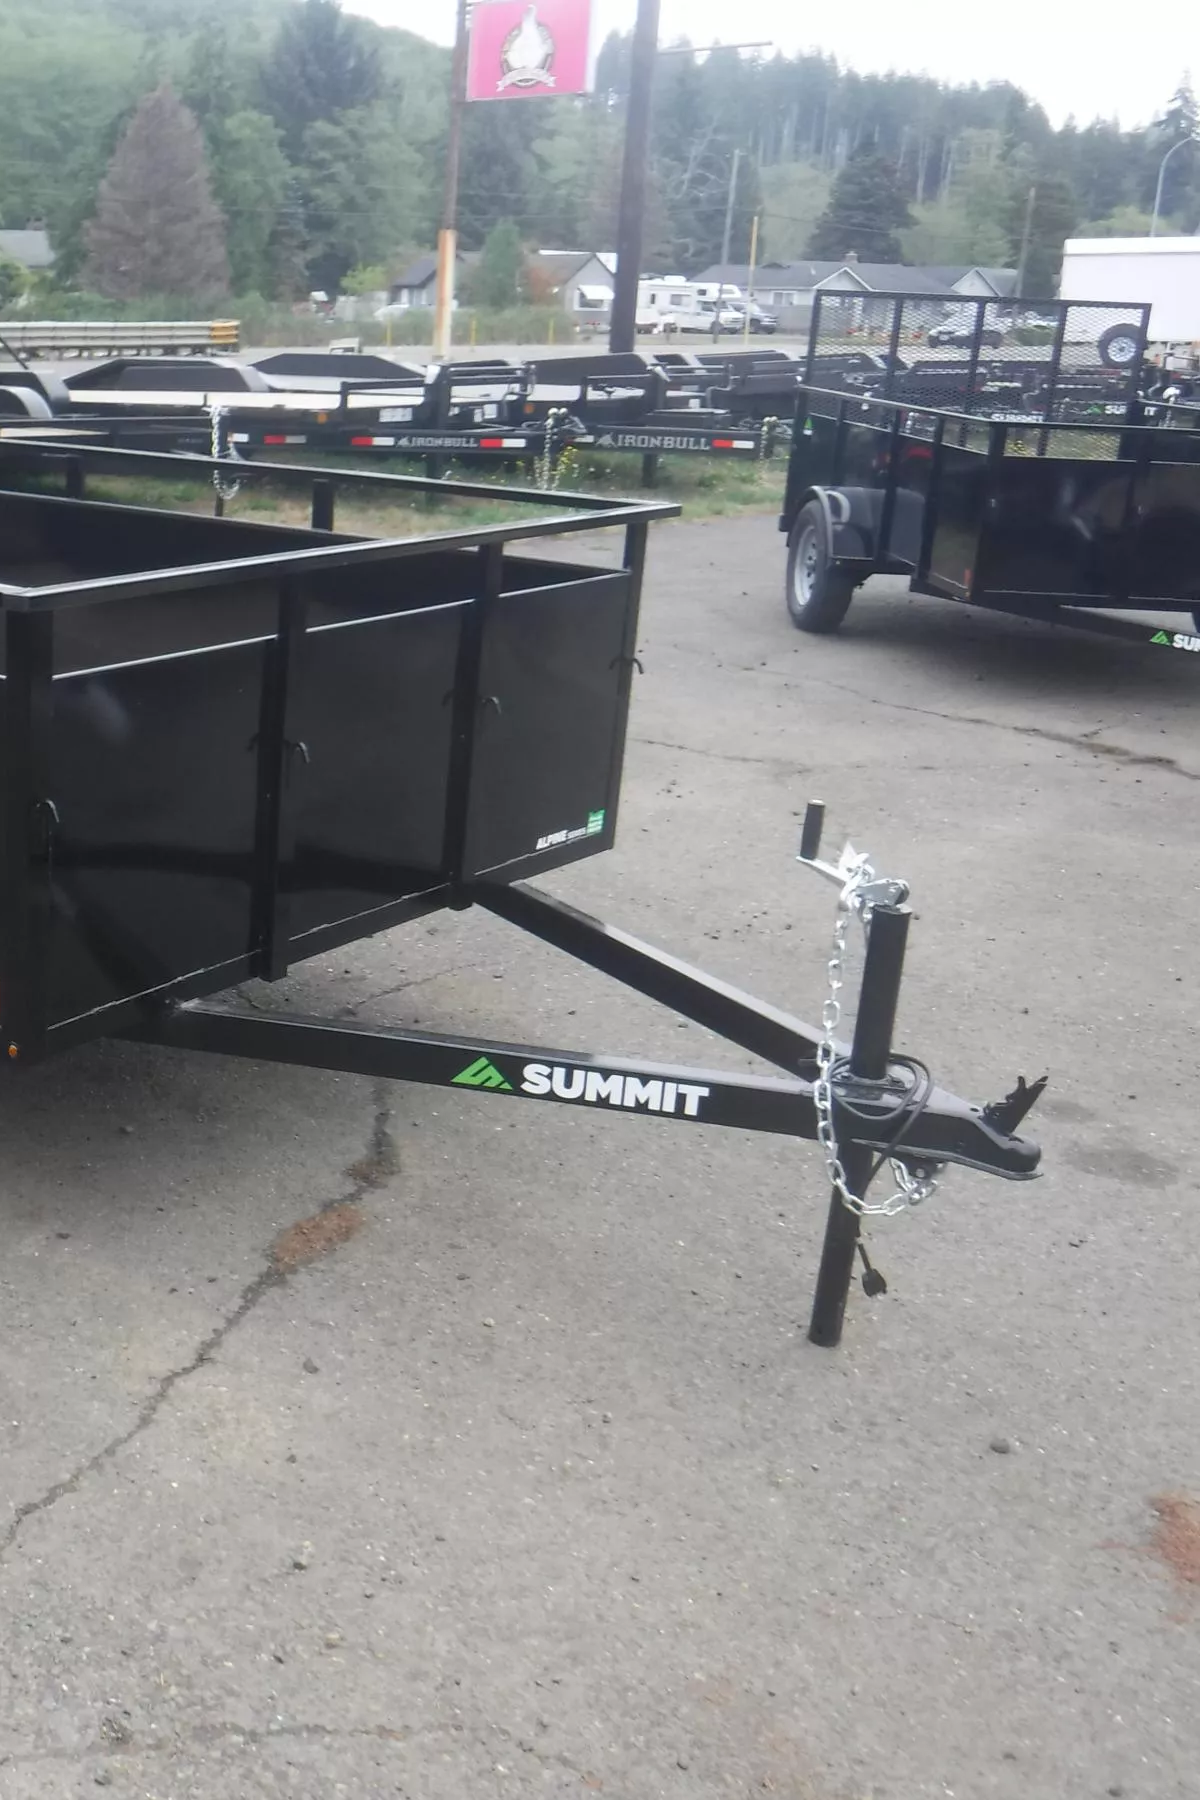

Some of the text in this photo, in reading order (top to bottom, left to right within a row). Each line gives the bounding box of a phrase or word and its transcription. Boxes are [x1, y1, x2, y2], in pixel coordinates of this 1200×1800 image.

[1104, 405, 1157, 416] SUIT
[411, 437, 478, 447] IRONBULL
[617, 434, 710, 450] IRONBULL
[520, 1063, 710, 1116] SUMMIT
